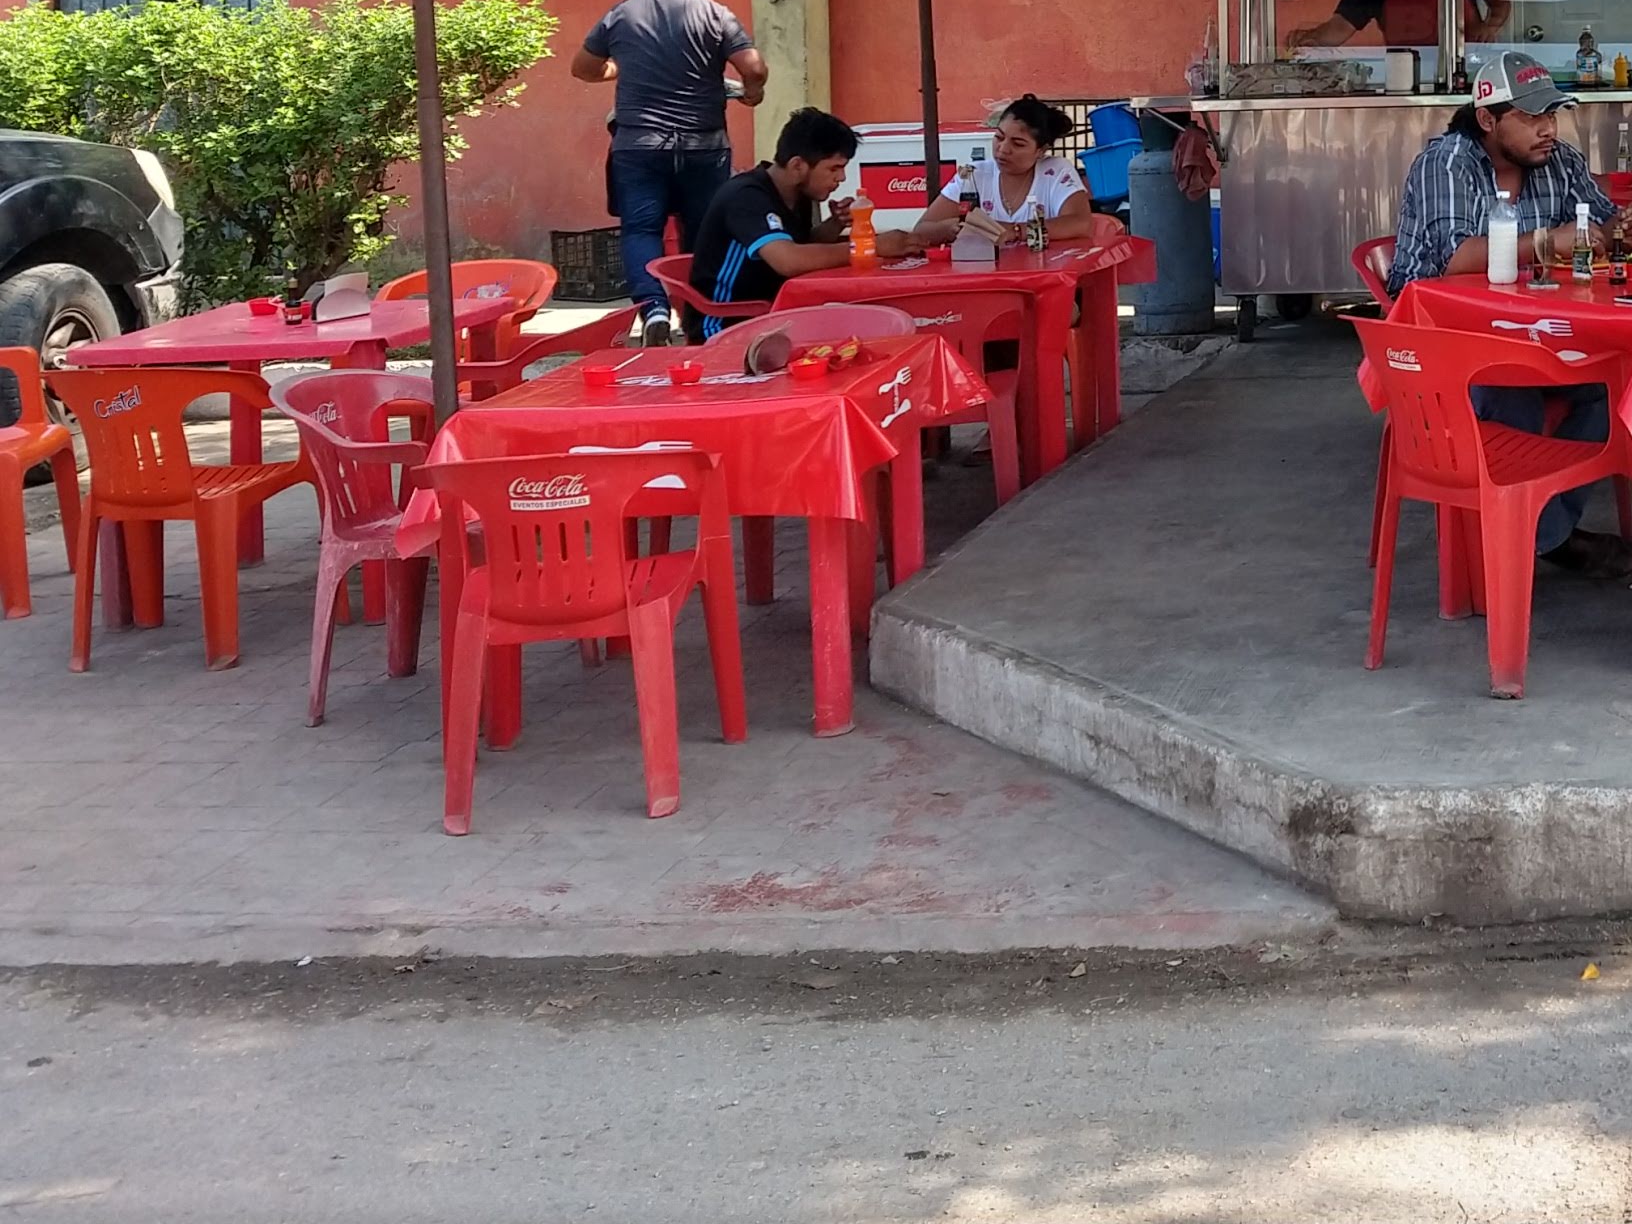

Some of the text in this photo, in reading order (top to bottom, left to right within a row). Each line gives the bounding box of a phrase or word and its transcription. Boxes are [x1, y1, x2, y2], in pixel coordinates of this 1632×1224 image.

[93, 385, 141, 419] Cristal
[508, 473, 586, 498] Coca-Cola
[512, 496, 587, 509] EVENTOS ESPECIALES
